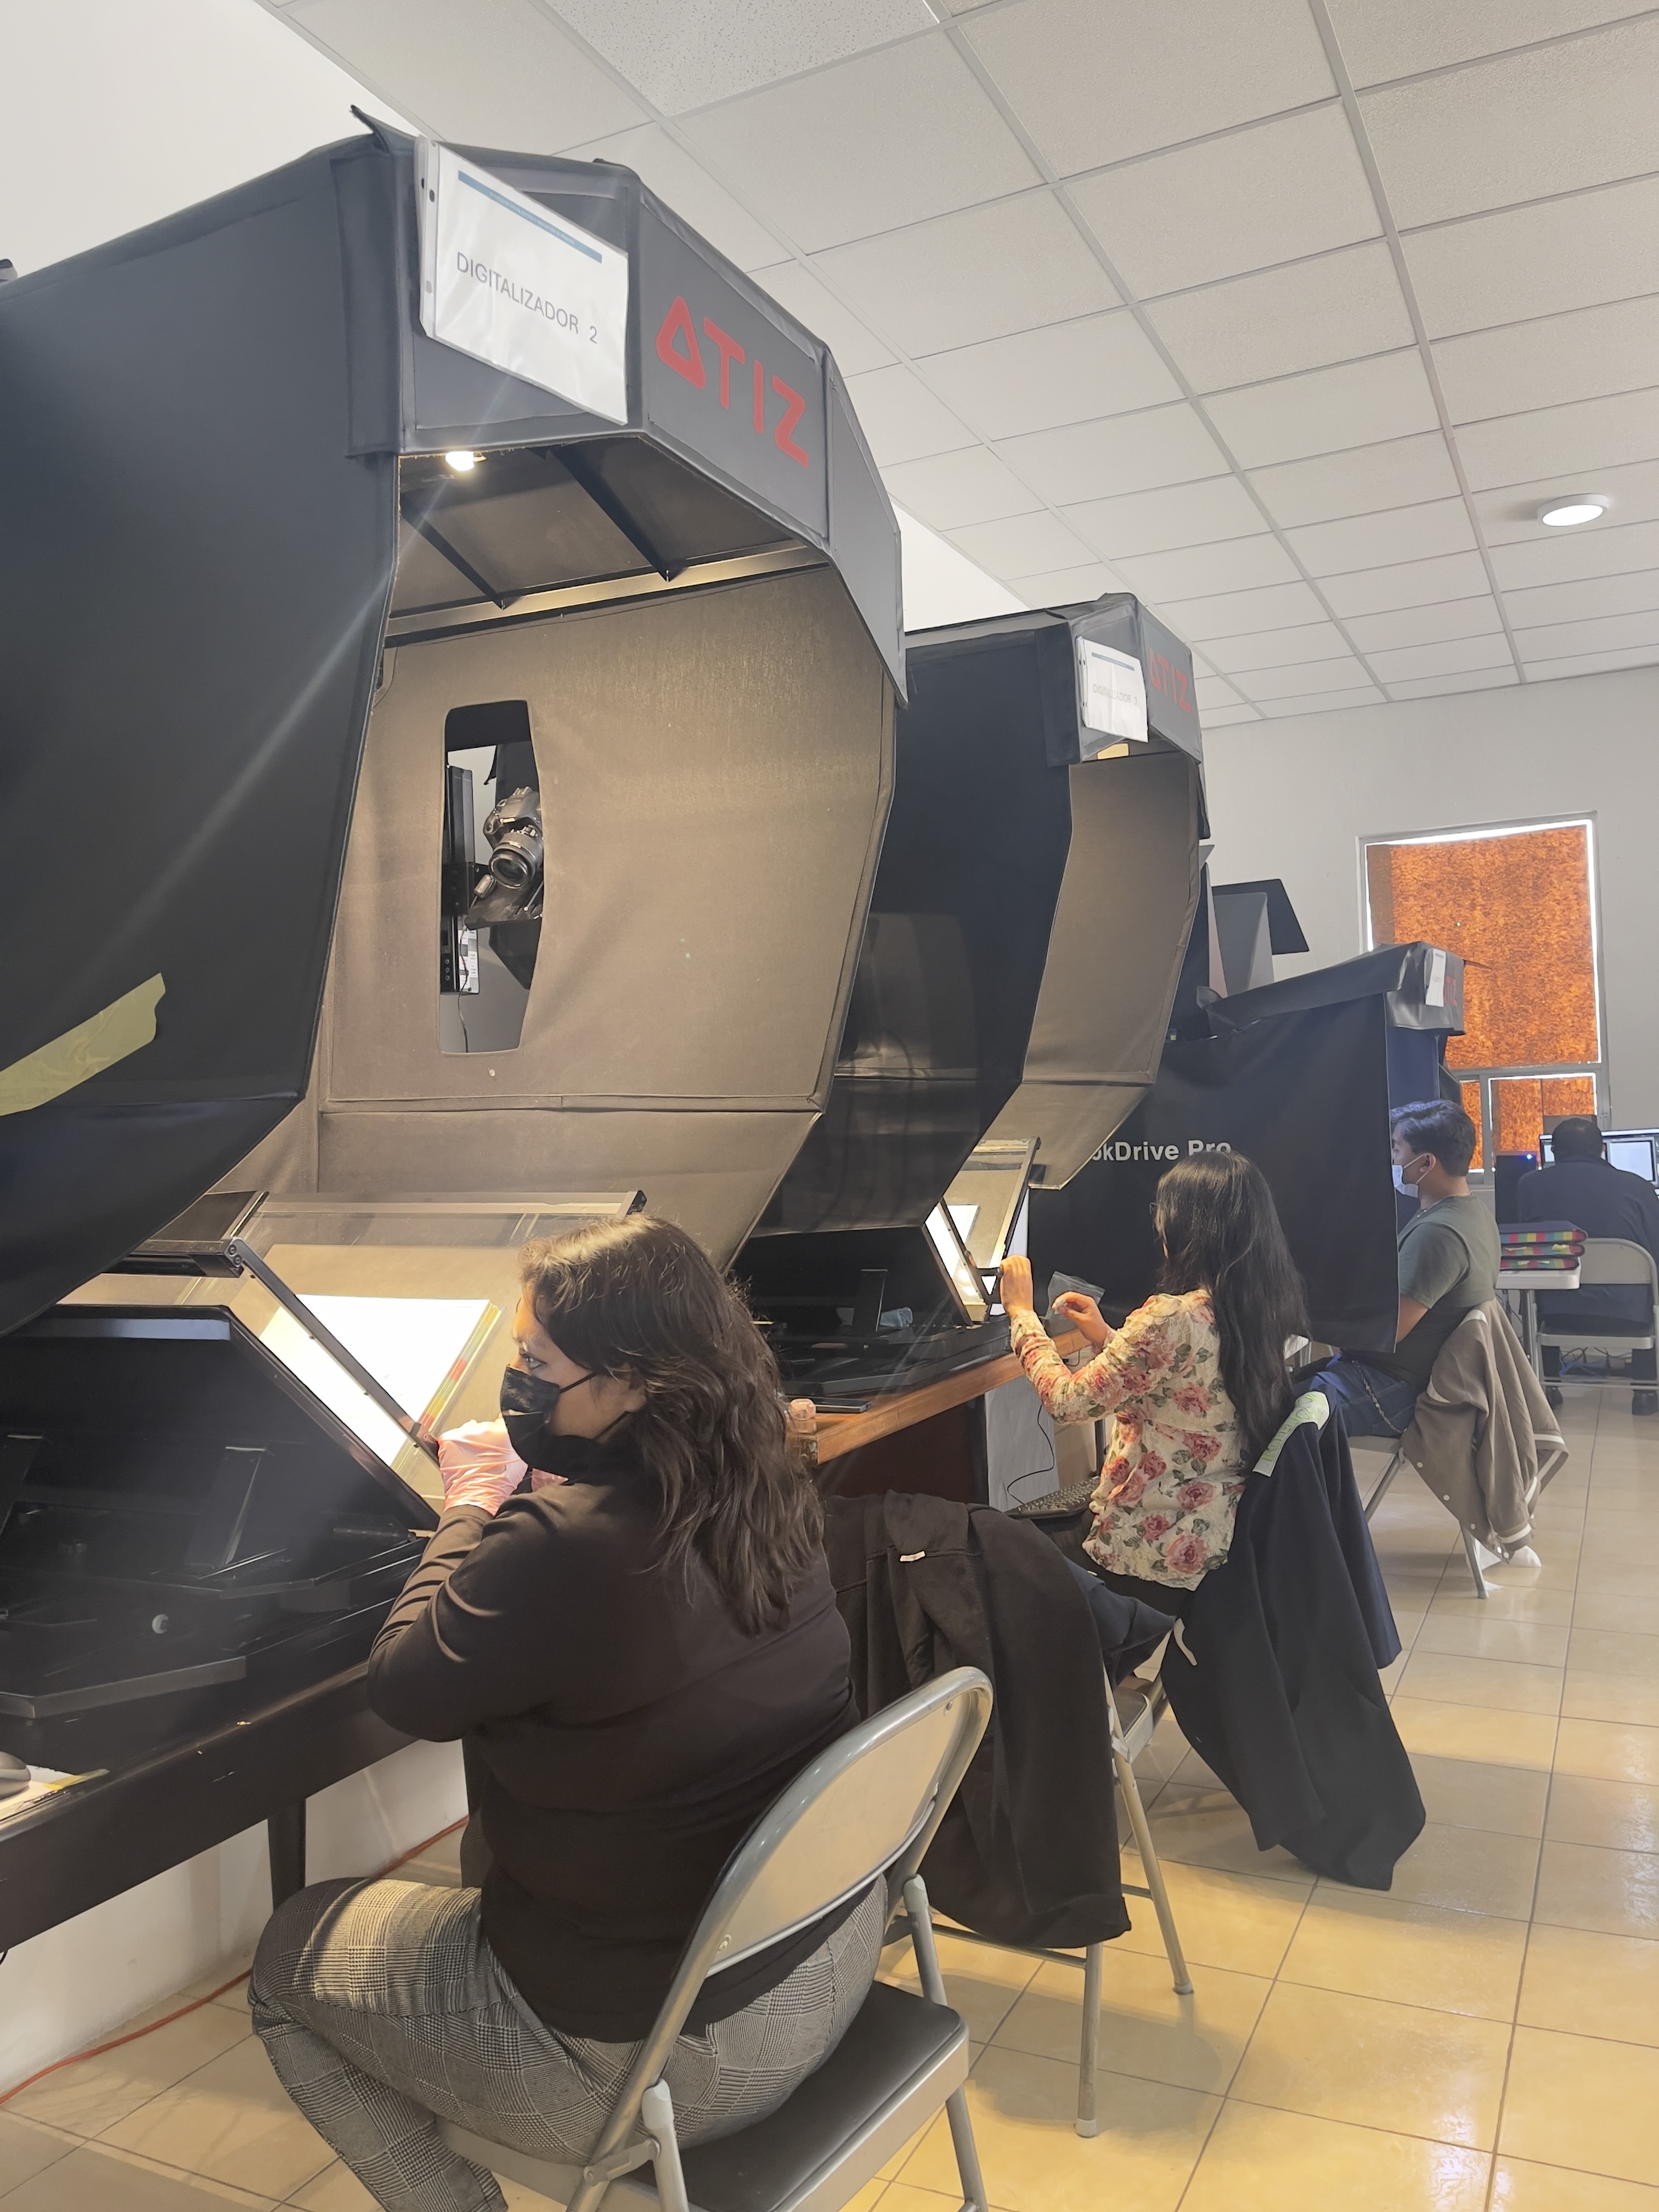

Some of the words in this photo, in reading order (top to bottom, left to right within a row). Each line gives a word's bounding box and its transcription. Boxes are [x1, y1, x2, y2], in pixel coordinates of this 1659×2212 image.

[456, 252, 579, 335] DIGITALIZADOR
[589, 325, 598, 345] 2
[1188, 1139, 1232, 1156] Pro
